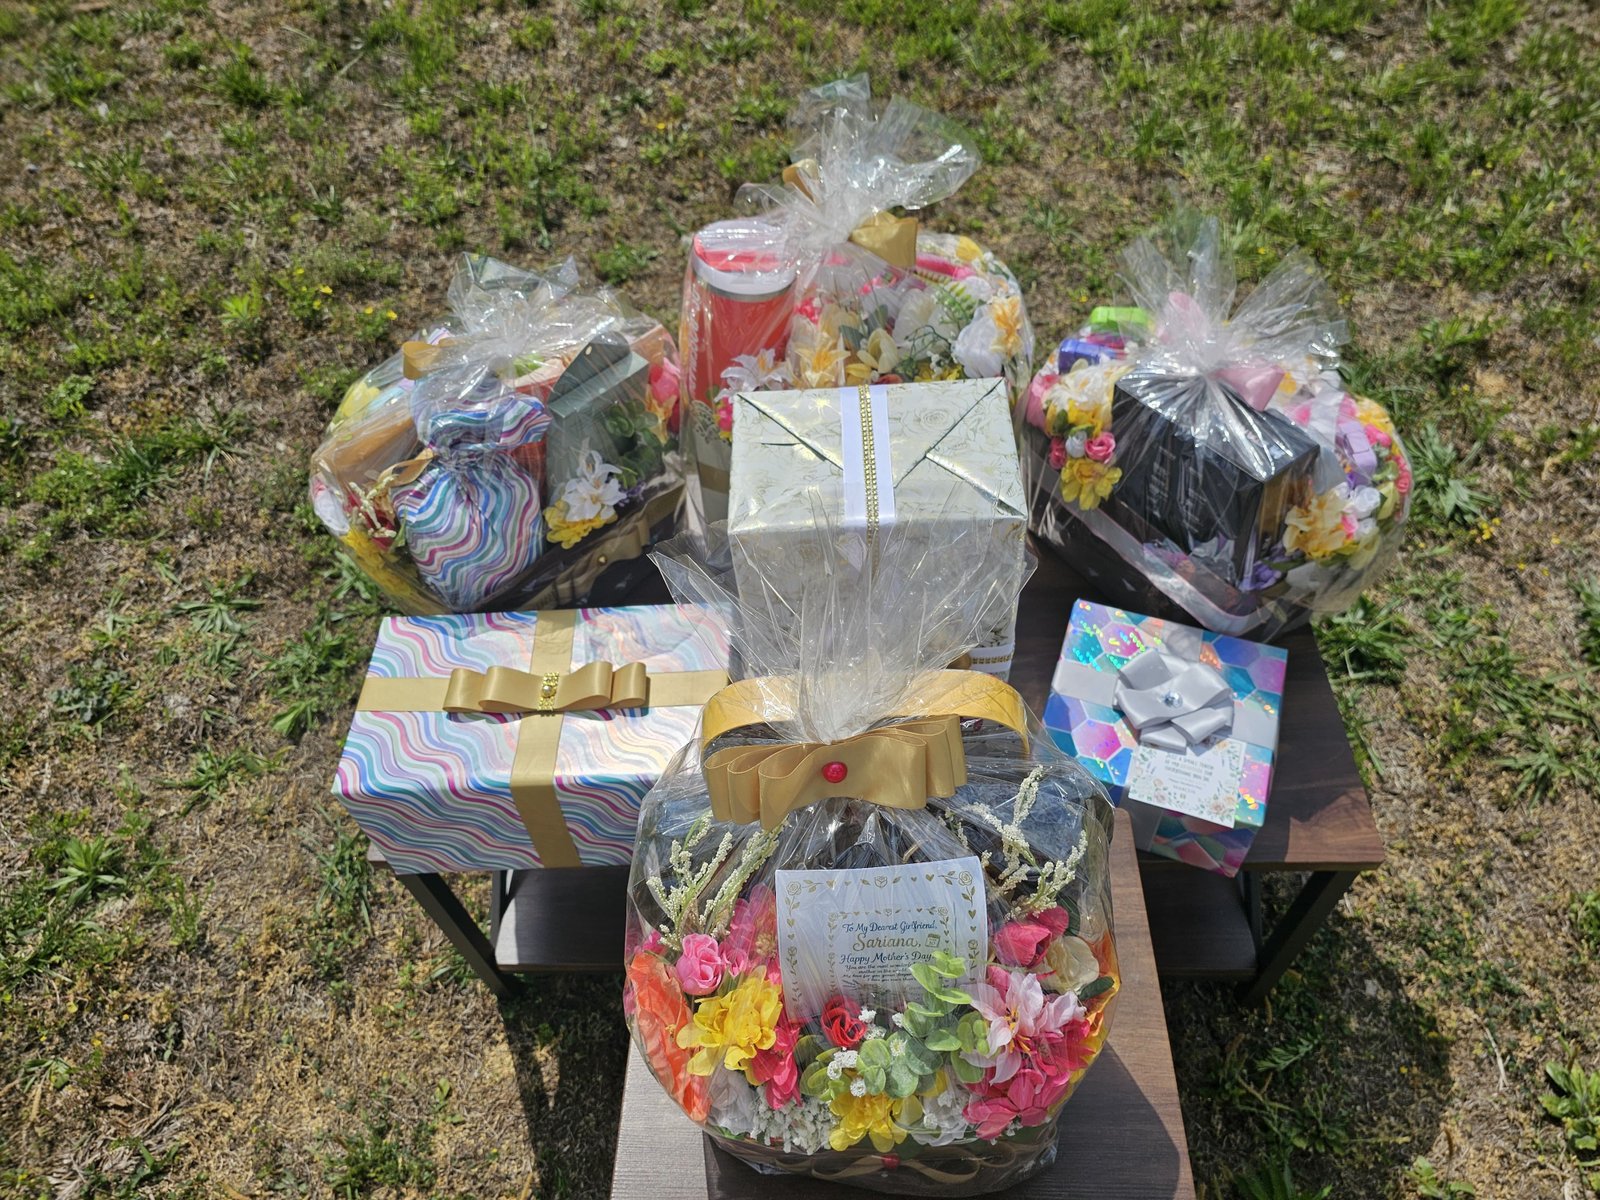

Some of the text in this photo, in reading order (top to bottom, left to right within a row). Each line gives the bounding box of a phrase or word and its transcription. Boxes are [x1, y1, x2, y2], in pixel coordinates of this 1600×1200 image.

[842, 922, 854, 933] To
[855, 923, 868, 935] My
[869, 921, 898, 932] Dearest
[852, 932, 921, 952] Sariana,
[839, 953, 870, 965] Happy
[871, 952, 909, 964] Mother's
